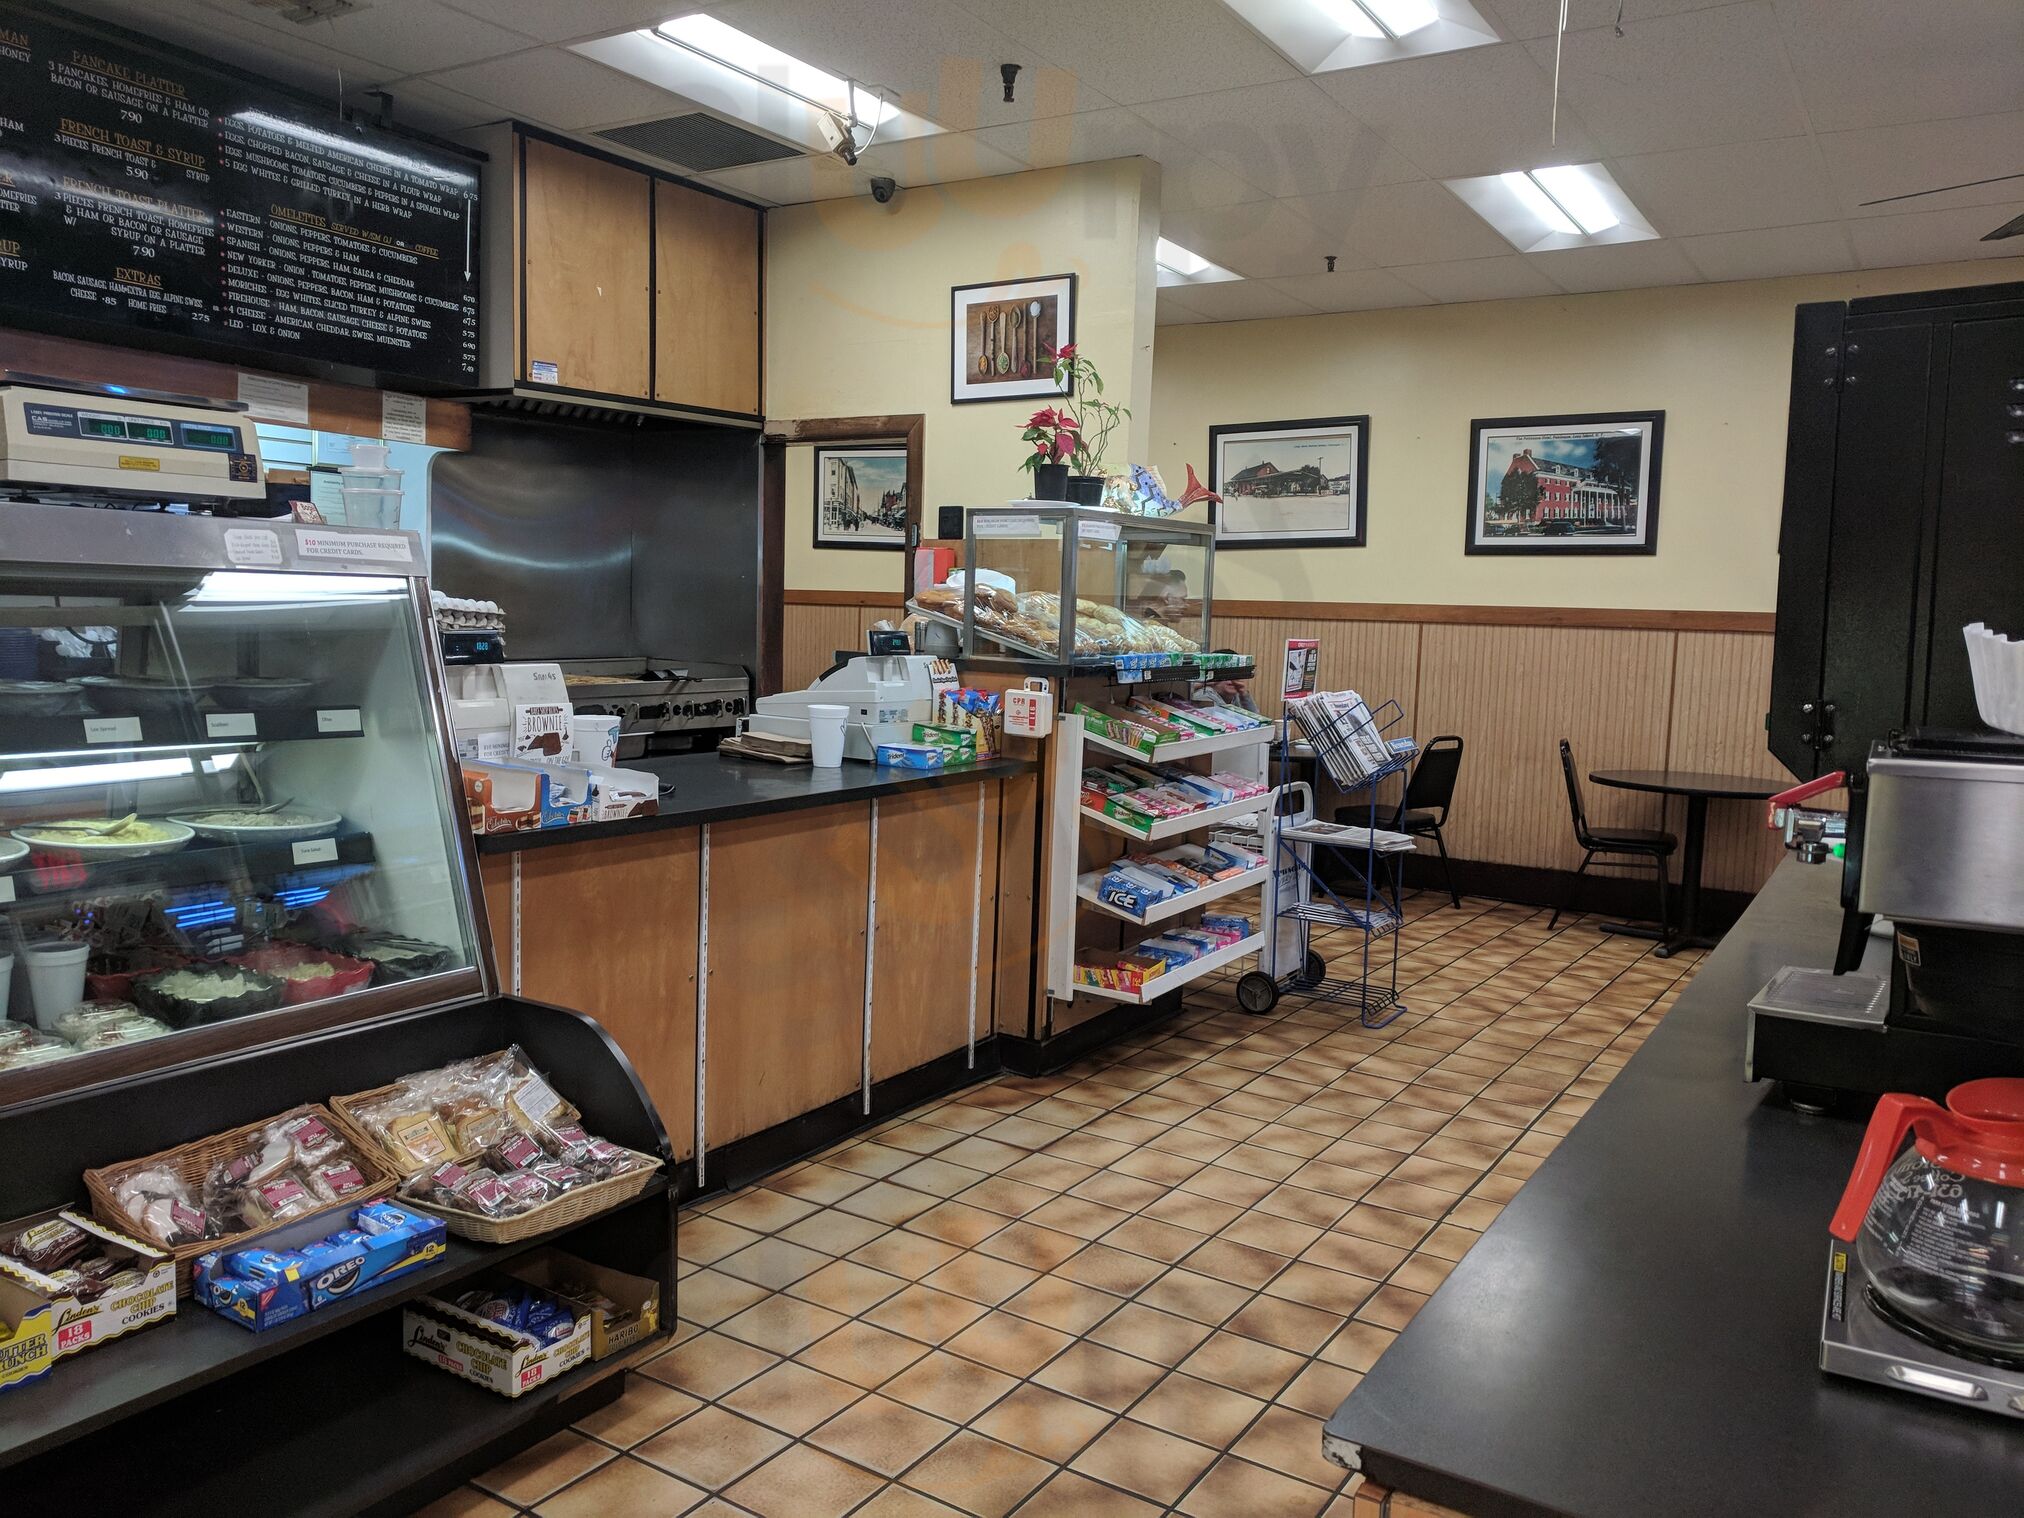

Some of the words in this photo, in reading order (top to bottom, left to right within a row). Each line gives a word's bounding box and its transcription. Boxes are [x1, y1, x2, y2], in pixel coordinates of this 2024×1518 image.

[73, 50, 131, 76] PANCAKE
[136, 71, 185, 95] PLATTER
[49, 61, 55, 70] 3
[113, 81, 162, 104] HOMEFRIES
[175, 100, 195, 114] HAM
[199, 108, 209, 118] OR
[51, 73, 82, 90] BACON
[86, 83, 98, 95] OR
[102, 88, 144, 109] SAUSAGE
[146, 102, 158, 113] ON
[163, 107, 169, 117] A
[173, 110, 208, 128] PLATTER
[61, 118, 109, 142] FRENCH
[114, 133, 151, 151] TOAST
[157, 145, 163, 155] &
[168, 148, 205, 166] SYRUP
[54, 134, 61, 143] 3
[62, 136, 89, 150] PIECES
[92, 145, 122, 159] FRENCH
[125, 154, 150, 166] TOAST
[186, 170, 210, 183] SYRUP
[248, 124, 285, 143] POTATOES
[296, 140, 324, 155] MELTED
[328, 149, 365, 167] AMERICAN
[366, 162, 392, 176] CHEESE
[411, 175, 437, 189] TOMATO
[439, 184, 458, 195] WRAP
[248, 139, 282, 156] CHOPPED
[313, 158, 345, 174] SAUSAGE
[355, 171, 381, 185] CHEESE
[382, 180, 390, 188] IN
[400, 184, 424, 197] FLOUR
[423, 191, 441, 203] WRAP
[63, 176, 110, 196] FRENCH
[116, 189, 153, 205] TOAST
[158, 200, 206, 219] PLATTER
[225, 159, 230, 167] 5
[233, 161, 248, 172] EGG
[251, 166, 281, 182] WHITES
[291, 179, 320, 193] GRILLED
[323, 187, 351, 203] TURKEY
[354, 196, 361, 204] IN
[364, 198, 369, 207] A
[372, 201, 390, 213] HERB
[392, 207, 412, 219] WRAP
[328, 178, 366, 193] CUCUMBERS
[374, 189, 399, 203] PEPPERS
[401, 198, 408, 206] IN
[415, 202, 441, 215] SPINACH
[443, 209, 460, 220] WRAP
[55, 192, 61, 200] 3
[64, 193, 94, 208] PIECES
[98, 203, 132, 217] FRENCH
[169, 219, 214, 237] HOMEFRIES
[77, 208, 99, 221] HAM
[103, 214, 115, 224] OR
[119, 218, 147, 231] BACON
[151, 225, 162, 236] OR
[165, 229, 203, 245] SAUSAGE
[270, 203, 326, 228] OMELETTES
[330, 222, 359, 235] SERVED
[415, 244, 438, 256] COFFEE
[111, 227, 140, 241] SYRUP
[144, 235, 155, 244] ON
[160, 239, 166, 247] A
[170, 240, 206, 256] PLATTER
[226, 209, 260, 224] EASTERN
[333, 236, 369, 252] TOMATOES
[379, 248, 418, 265] CUCUMBERS
[227, 223, 264, 238] WESTERN
[303, 242, 333, 256] PEPPERS
[342, 252, 360, 262] HAM
[116, 267, 161, 286] EXTRAS
[226, 236, 260, 251] SPANISH
[353, 267, 374, 279] SALSA
[384, 274, 415, 289] CHEDDAR
[227, 251, 244, 261] NEW
[248, 255, 276, 269] YORKER
[284, 264, 305, 276] ONION
[379, 286, 417, 302] MUSHROOMS
[424, 296, 460, 311] CUCUMBERS
[228, 264, 259, 279] DELUXE
[357, 294, 374, 304] HAM
[383, 299, 415, 313] POTATOES
[71, 288, 97, 300] CHEESE
[128, 299, 147, 310] HOME
[150, 303, 167, 314] FRIES
[163, 293, 183, 304] ALPINE
[228, 279, 267, 294] MORICHES
[275, 288, 290, 298] EGG
[324, 299, 347, 310] SLICED
[350, 304, 377, 317] TURKEY
[387, 312, 409, 324] ALPINE
[411, 318, 431, 329] SWISS
[229, 291, 271, 308] FIREHOUSE
[362, 320, 387, 332] CHEESE
[396, 327, 427, 339] POTATOES
[229, 305, 234, 313] 4
[237, 307, 266, 320] CHEESE
[377, 335, 411, 349] MUENSTER
[229, 319, 243, 329] LEO
[252, 324, 267, 334] LOX
[278, 329, 300, 340] ONION
[527, 715, 562, 732] BROWNIE
[1108, 891, 1138, 909] ICE
[424, 1245, 435, 1254] 12
[316, 1256, 366, 1291] OREO
[110, 1280, 174, 1312] CHOCOLATE
[130, 1297, 157, 1314] CHIP
[52, 1305, 102, 1336] Linden's
[122, 1302, 165, 1325] COOKIES
[60, 1332, 90, 1350] PACKS
[68, 1323, 83, 1336] 18
[407, 1324, 448, 1354] Linden's
[553, 1332, 590, 1356] CHOCOLATE
[608, 1325, 639, 1344] HARIBO
[0, 1334, 47, 1358] UTTER
[0, 1344, 48, 1372] RUNCH
[455, 1341, 507, 1370] CHOCOLATE
[559, 1351, 585, 1368] COOKIES
[565, 1345, 581, 1359] CHIP
[469, 1369, 493, 1384] COOKIES
[470, 1358, 492, 1375] CHIP
[515, 1352, 548, 1378] Linden's
[522, 1373, 541, 1387] PACKS
[527, 1368, 538, 1378] 18
